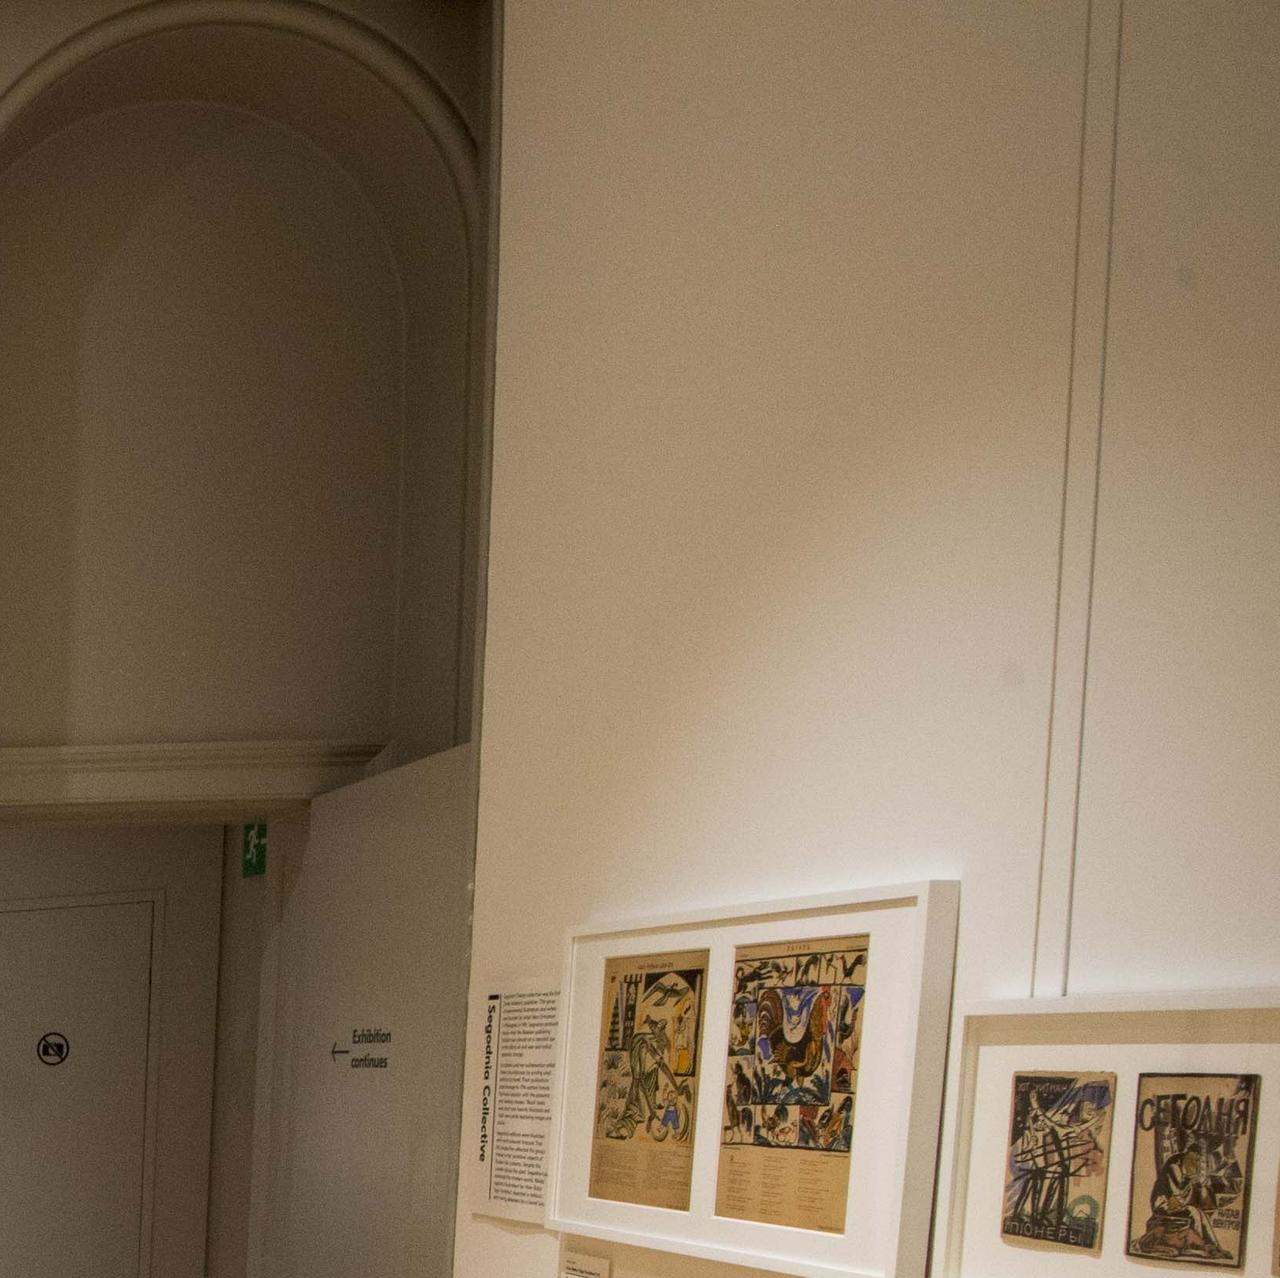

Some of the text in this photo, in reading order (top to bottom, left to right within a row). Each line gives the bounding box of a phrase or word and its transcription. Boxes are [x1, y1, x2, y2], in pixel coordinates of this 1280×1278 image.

[351, 1028, 392, 1046] Exhibition
[350, 1052, 388, 1069] continues
[479, 1004, 496, 1162] Segodnia Collective
